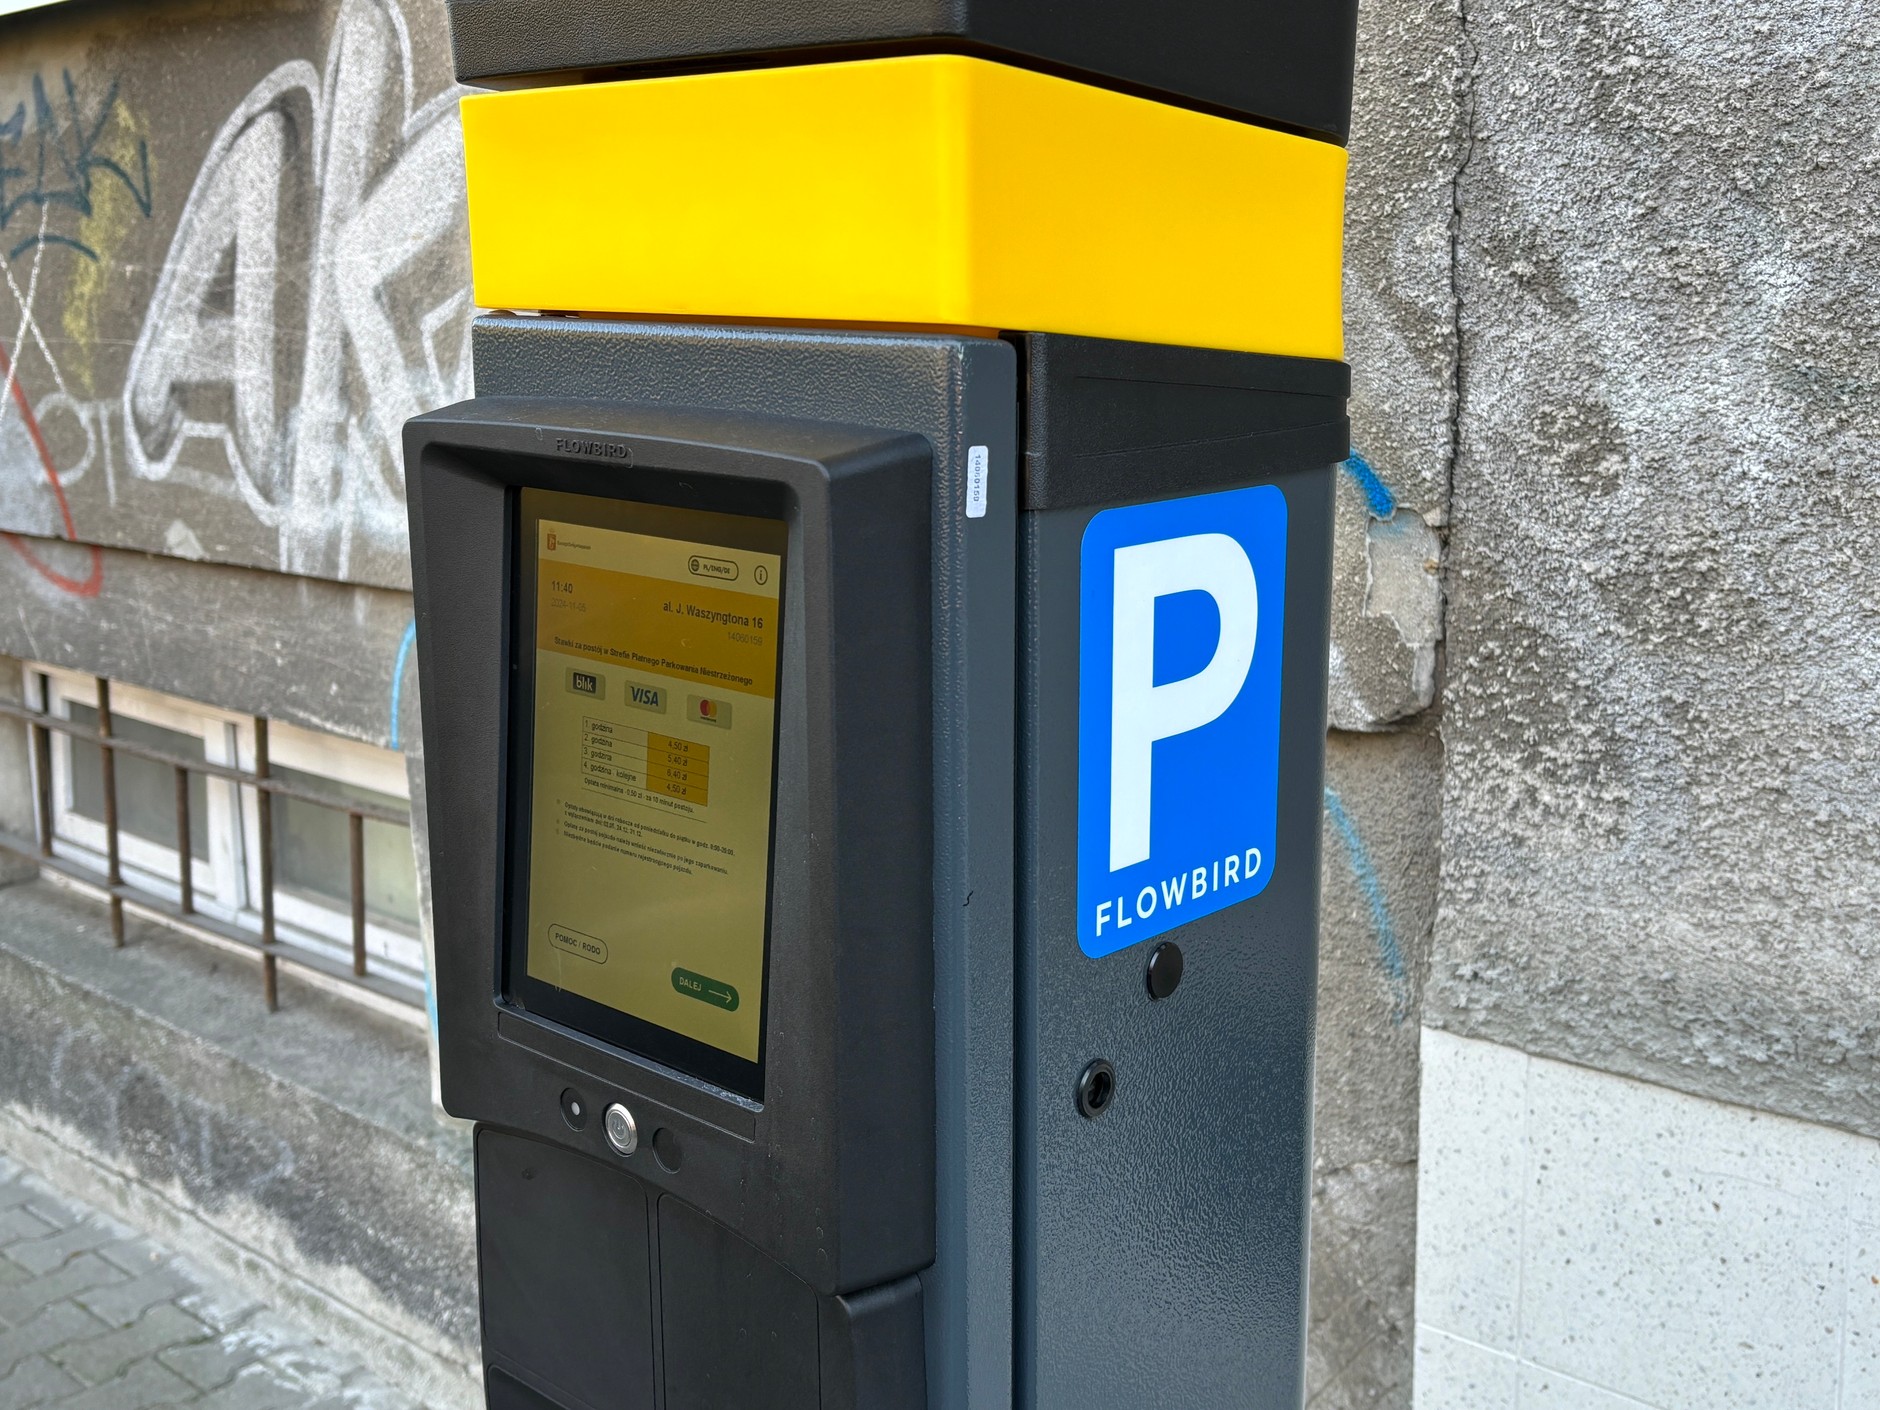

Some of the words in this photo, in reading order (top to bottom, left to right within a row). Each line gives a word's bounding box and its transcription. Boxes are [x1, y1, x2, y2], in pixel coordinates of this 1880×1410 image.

[556, 438, 627, 458] FLOWBIRD
[552, 581, 573, 594] 11:40
[663, 601, 674, 612] al.
[676, 603, 684, 614] J.
[686, 604, 749, 625] Waszyngtona
[752, 616, 763, 629] 16
[575, 642, 582, 650] za
[661, 659, 699, 674] Parkowania
[700, 666, 753, 686] Niestrzeżonego
[576, 674, 593, 691] blik
[630, 686, 659, 706] VISA
[1109, 532, 1258, 872] P
[591, 722, 613, 734] godzina
[591, 735, 613, 748] godzina
[591, 748, 612, 761] godzina
[590, 763, 612, 775] godzina
[1096, 847, 1261, 937] FLOWBIRD
[555, 932, 578, 948] POMOC
[582, 942, 601, 955] RODO
[679, 976, 702, 992] DALEJ
